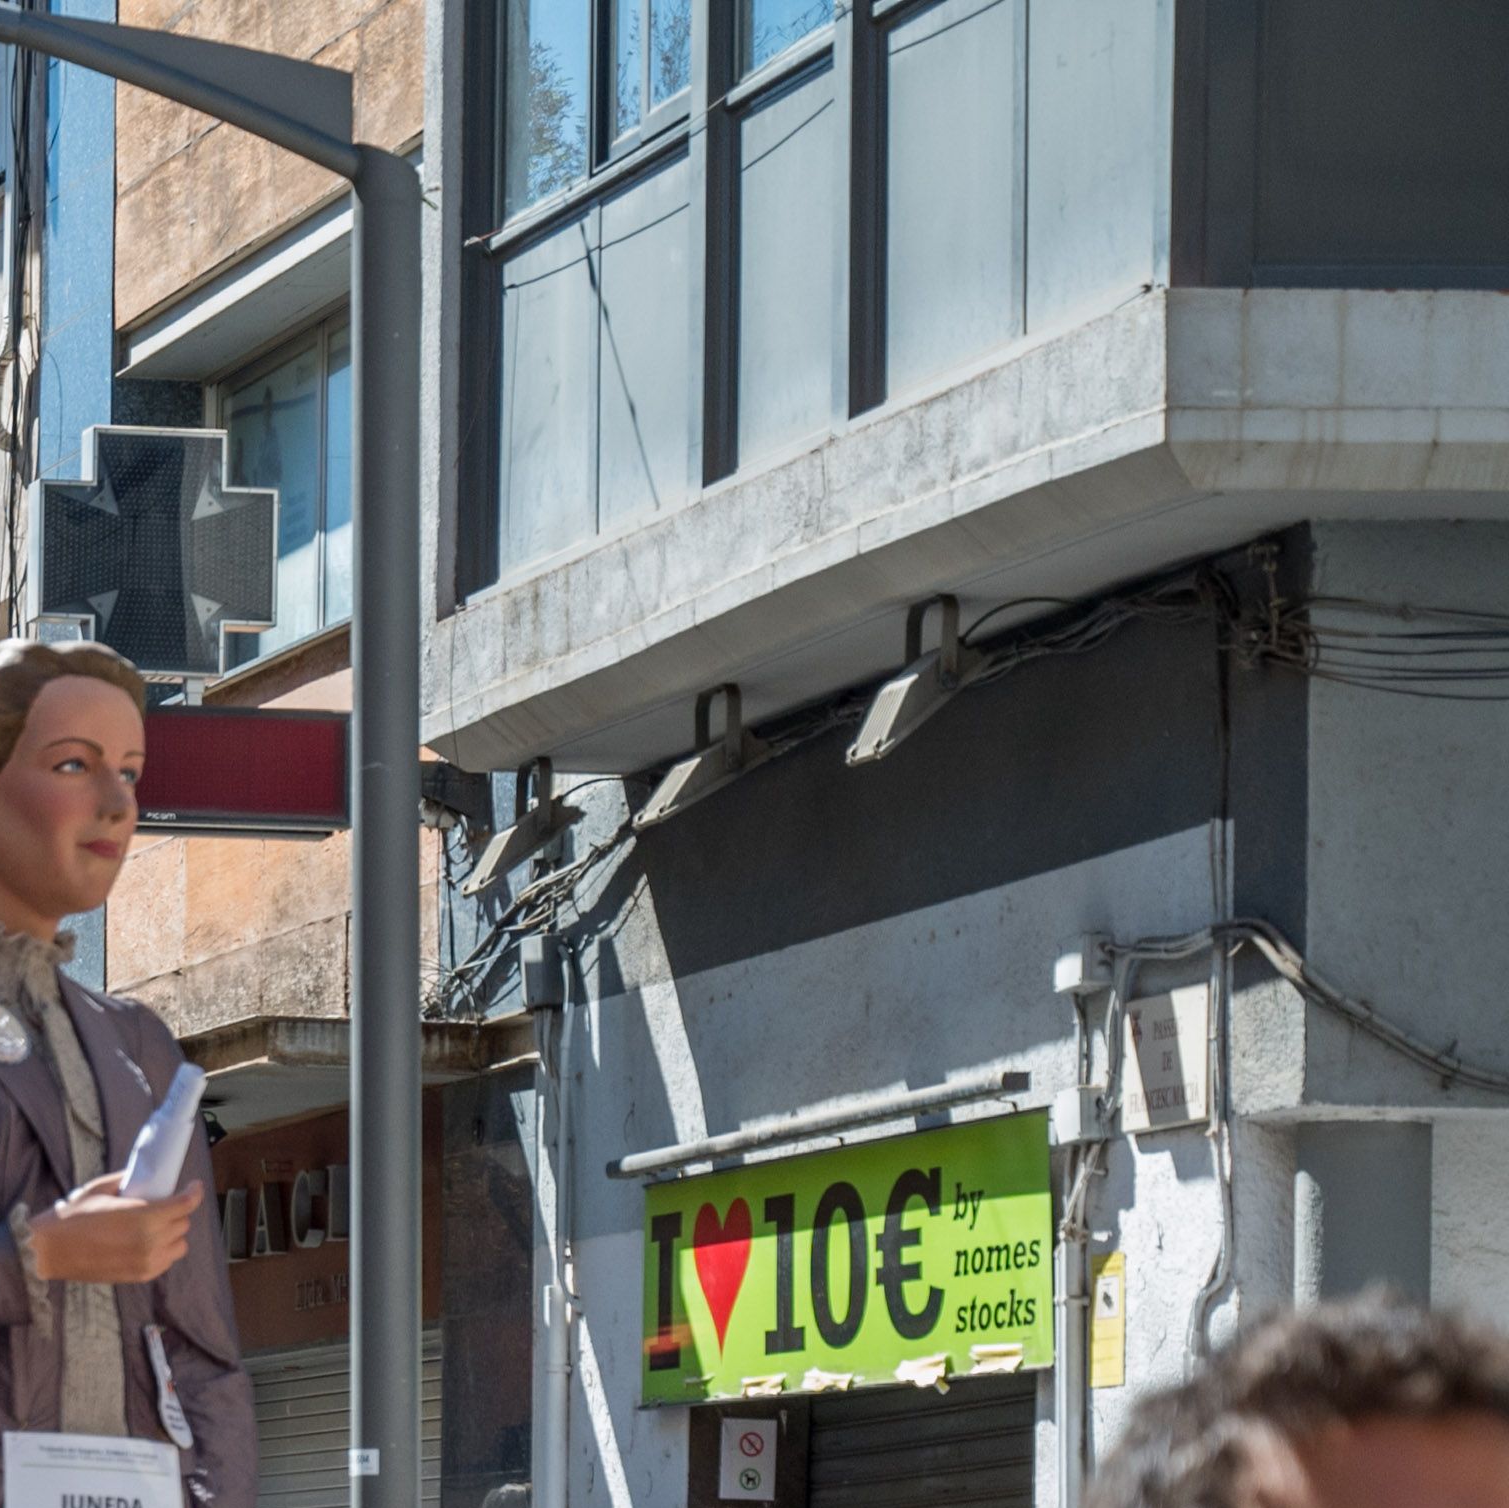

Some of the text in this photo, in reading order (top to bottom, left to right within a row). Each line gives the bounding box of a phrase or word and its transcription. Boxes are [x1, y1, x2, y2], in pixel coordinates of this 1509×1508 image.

[953, 1183, 984, 1230] by
[763, 1166, 944, 1356] 10€
[953, 1235, 1041, 1279] nomes
[954, 1289, 1036, 1334] stocks
